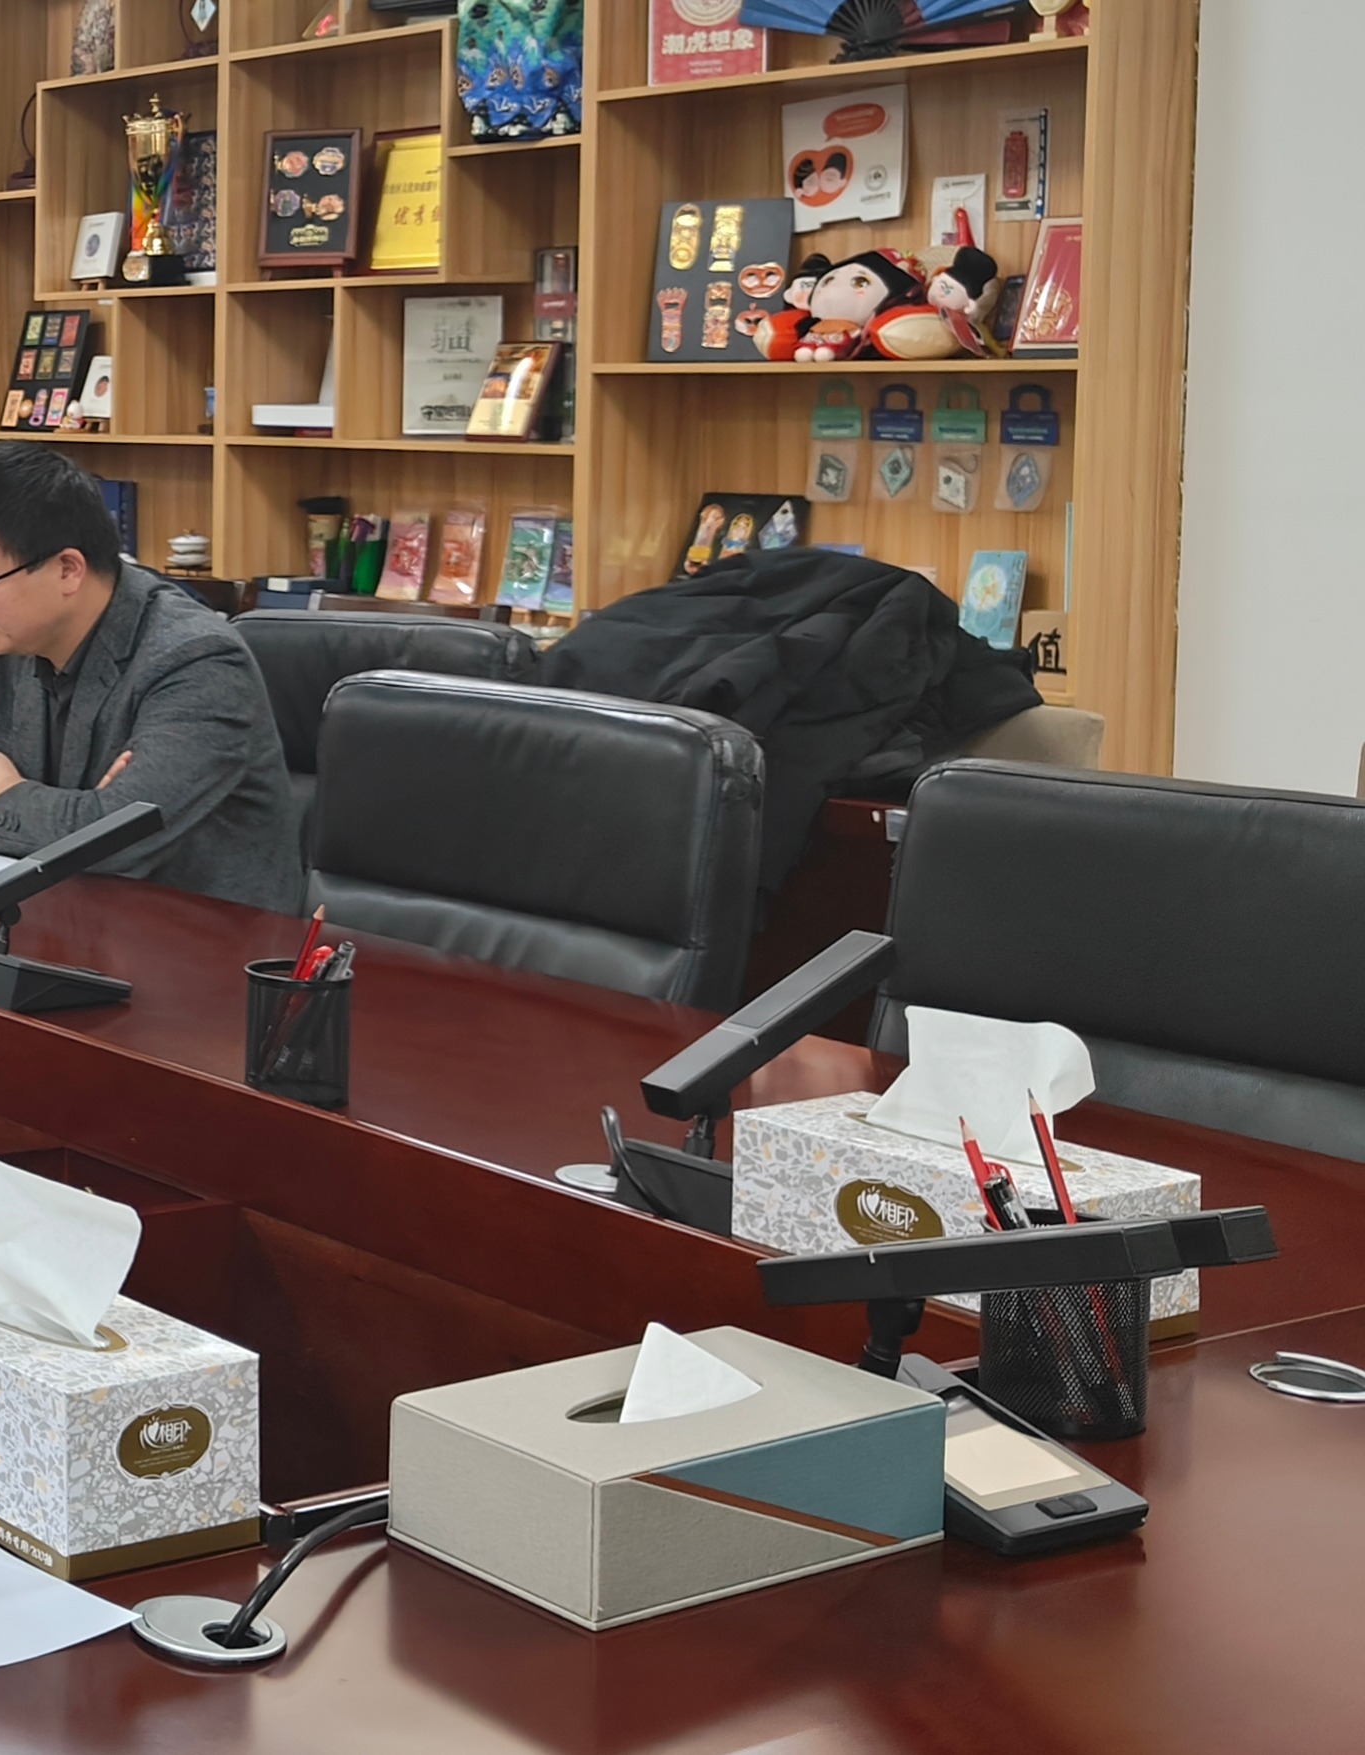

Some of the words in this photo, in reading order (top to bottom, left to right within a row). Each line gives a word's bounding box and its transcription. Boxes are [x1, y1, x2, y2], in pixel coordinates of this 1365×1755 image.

[857, 1185, 919, 1231] 心相印
[140, 1416, 192, 1449] 心相印
